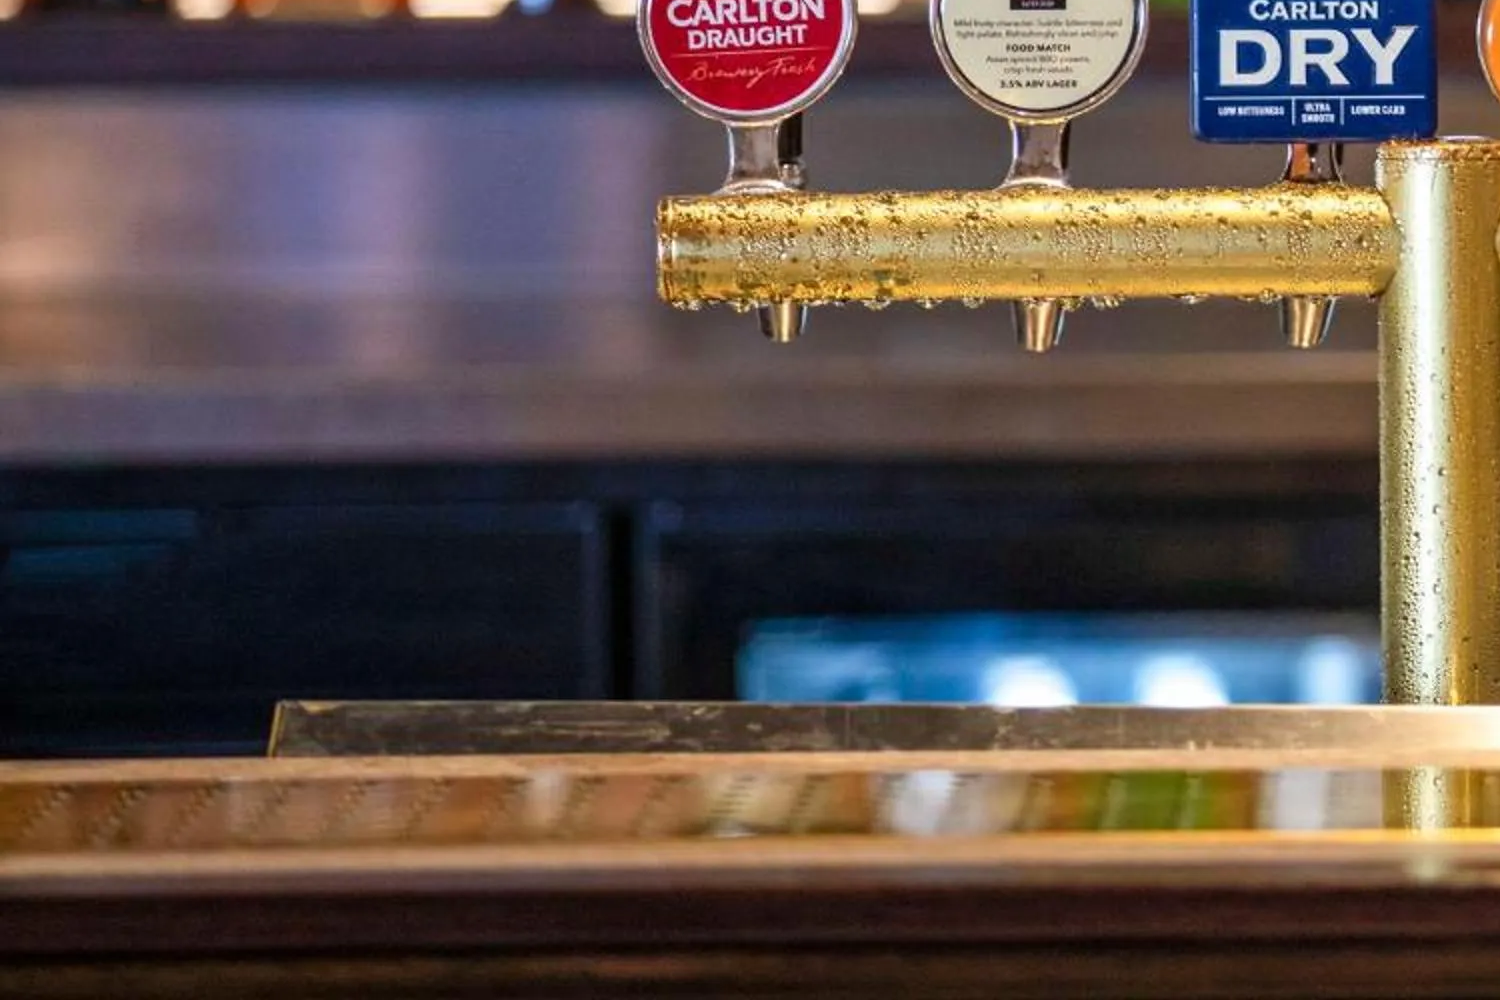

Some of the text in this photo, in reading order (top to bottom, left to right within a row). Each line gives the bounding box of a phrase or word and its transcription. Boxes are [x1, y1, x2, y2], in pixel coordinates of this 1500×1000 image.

[687, 24, 807, 50] DRAUGHT
[1006, 43, 1071, 52] FOOD MATCH
[1217, 25, 1419, 86] DRY
[688, 56, 816, 89] Brewery Fresh
[1000, 79, 1078, 89] 3.5% ABV LAGER
[1350, 105, 1381, 116] LOWER
